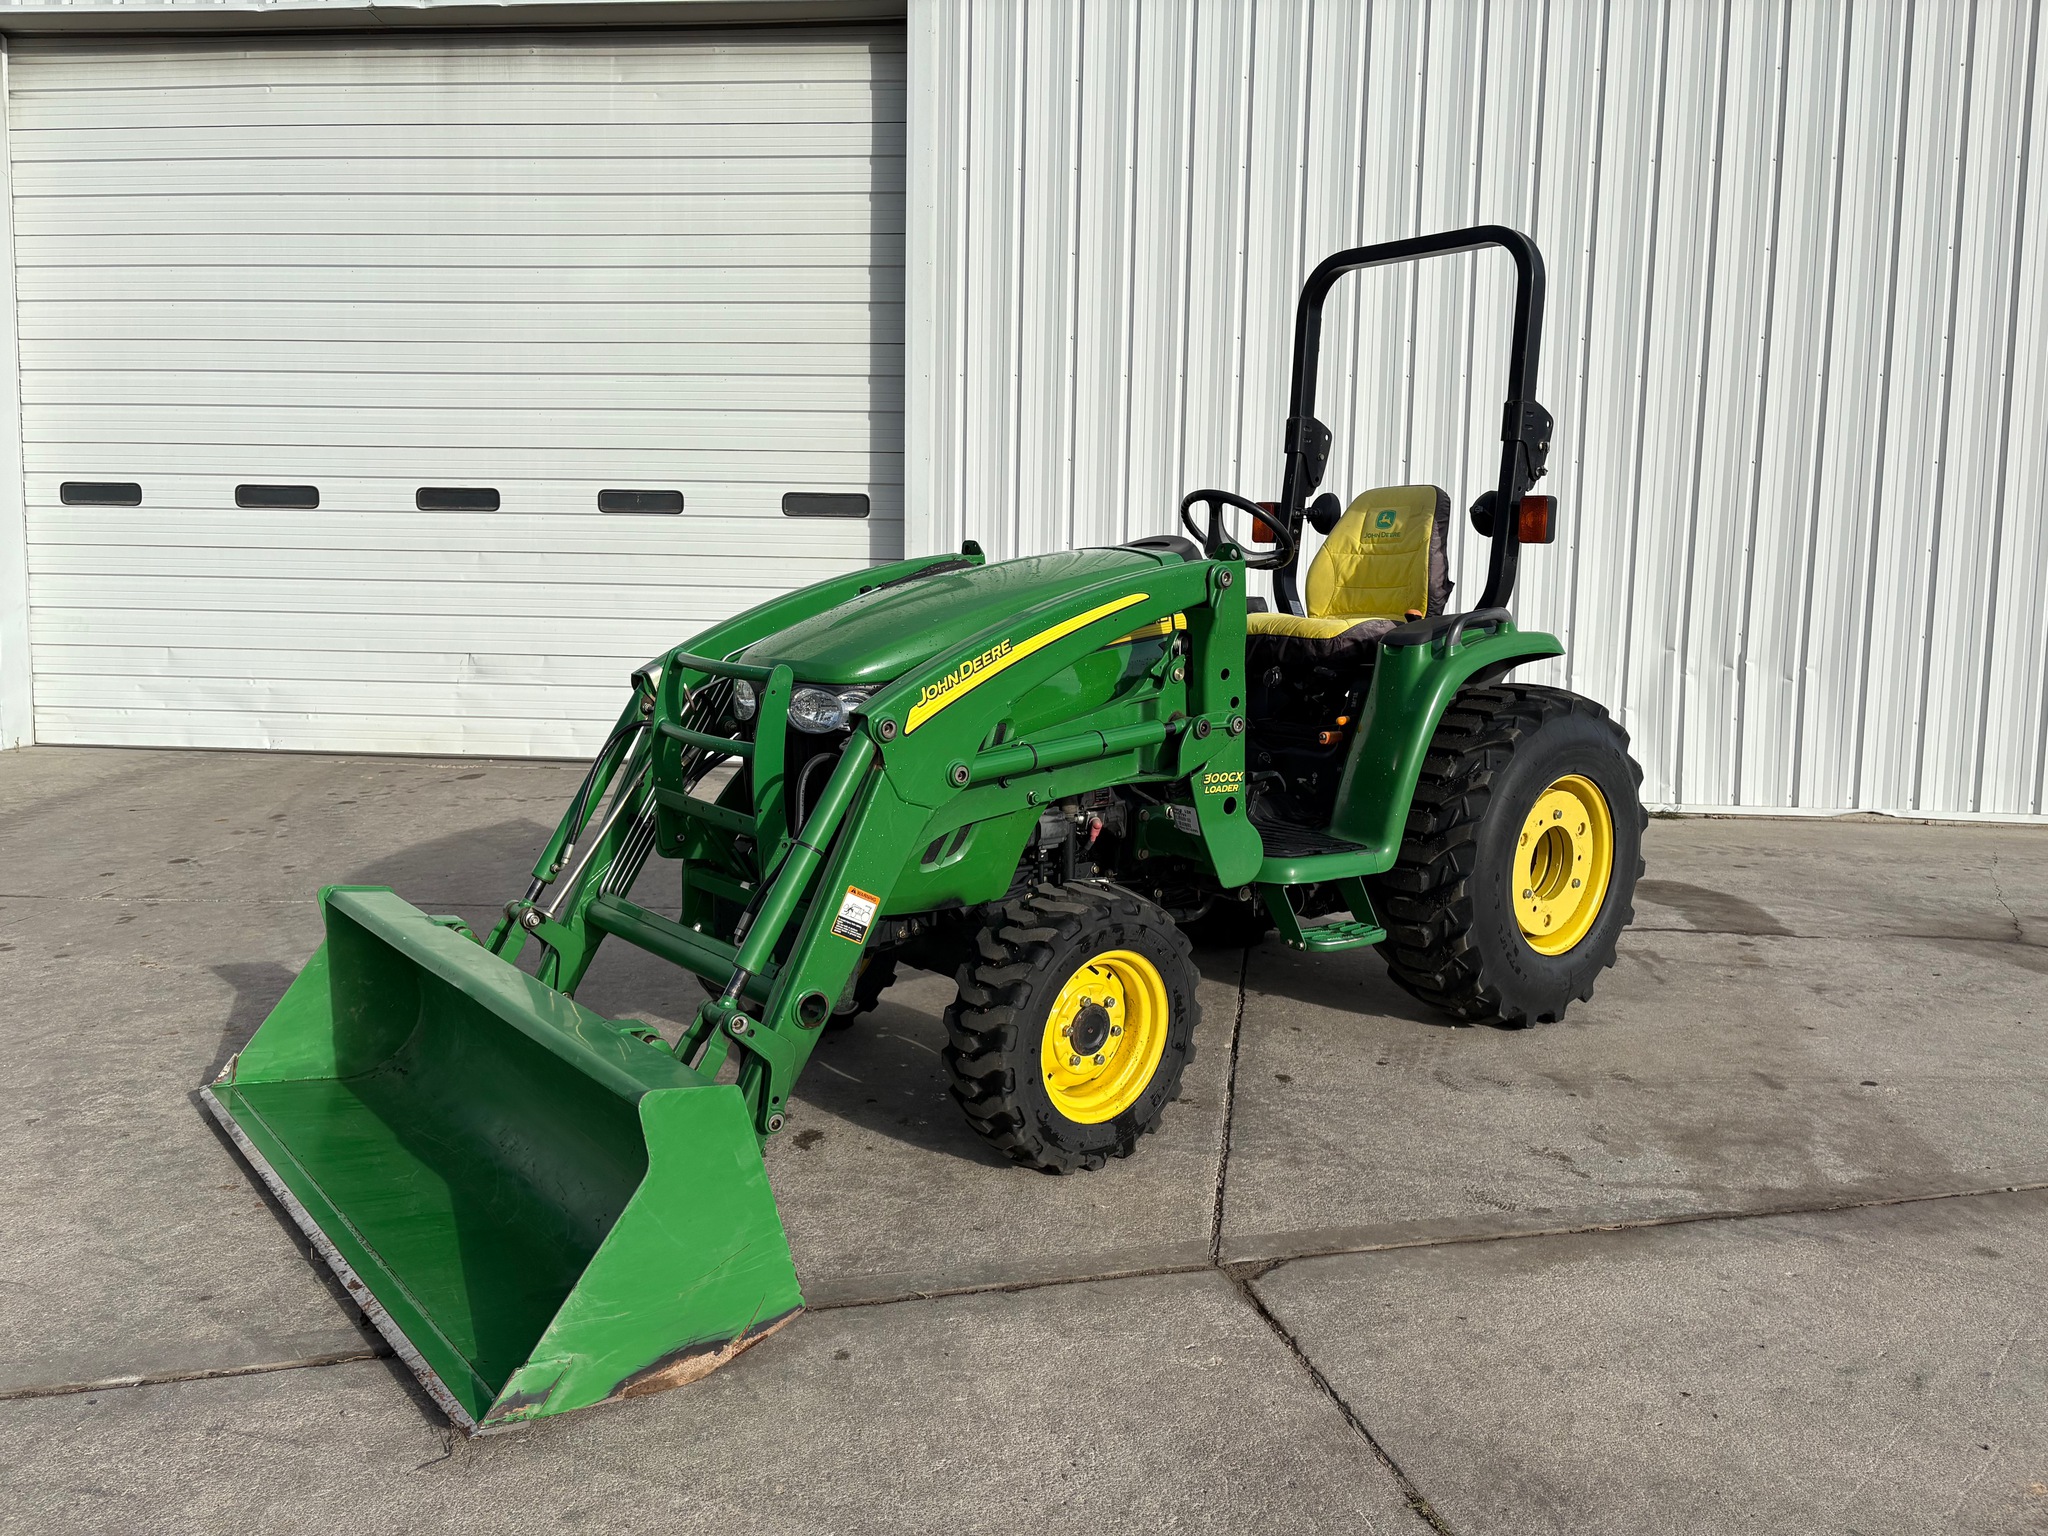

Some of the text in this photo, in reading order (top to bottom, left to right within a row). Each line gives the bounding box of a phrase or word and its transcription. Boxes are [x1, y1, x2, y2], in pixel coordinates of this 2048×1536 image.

[917, 638, 1013, 707] JOHN DEERE
[1203, 771, 1244, 784] 300CX
[1204, 784, 1239, 794] LOADER
[857, 891, 876, 902] WARNING
